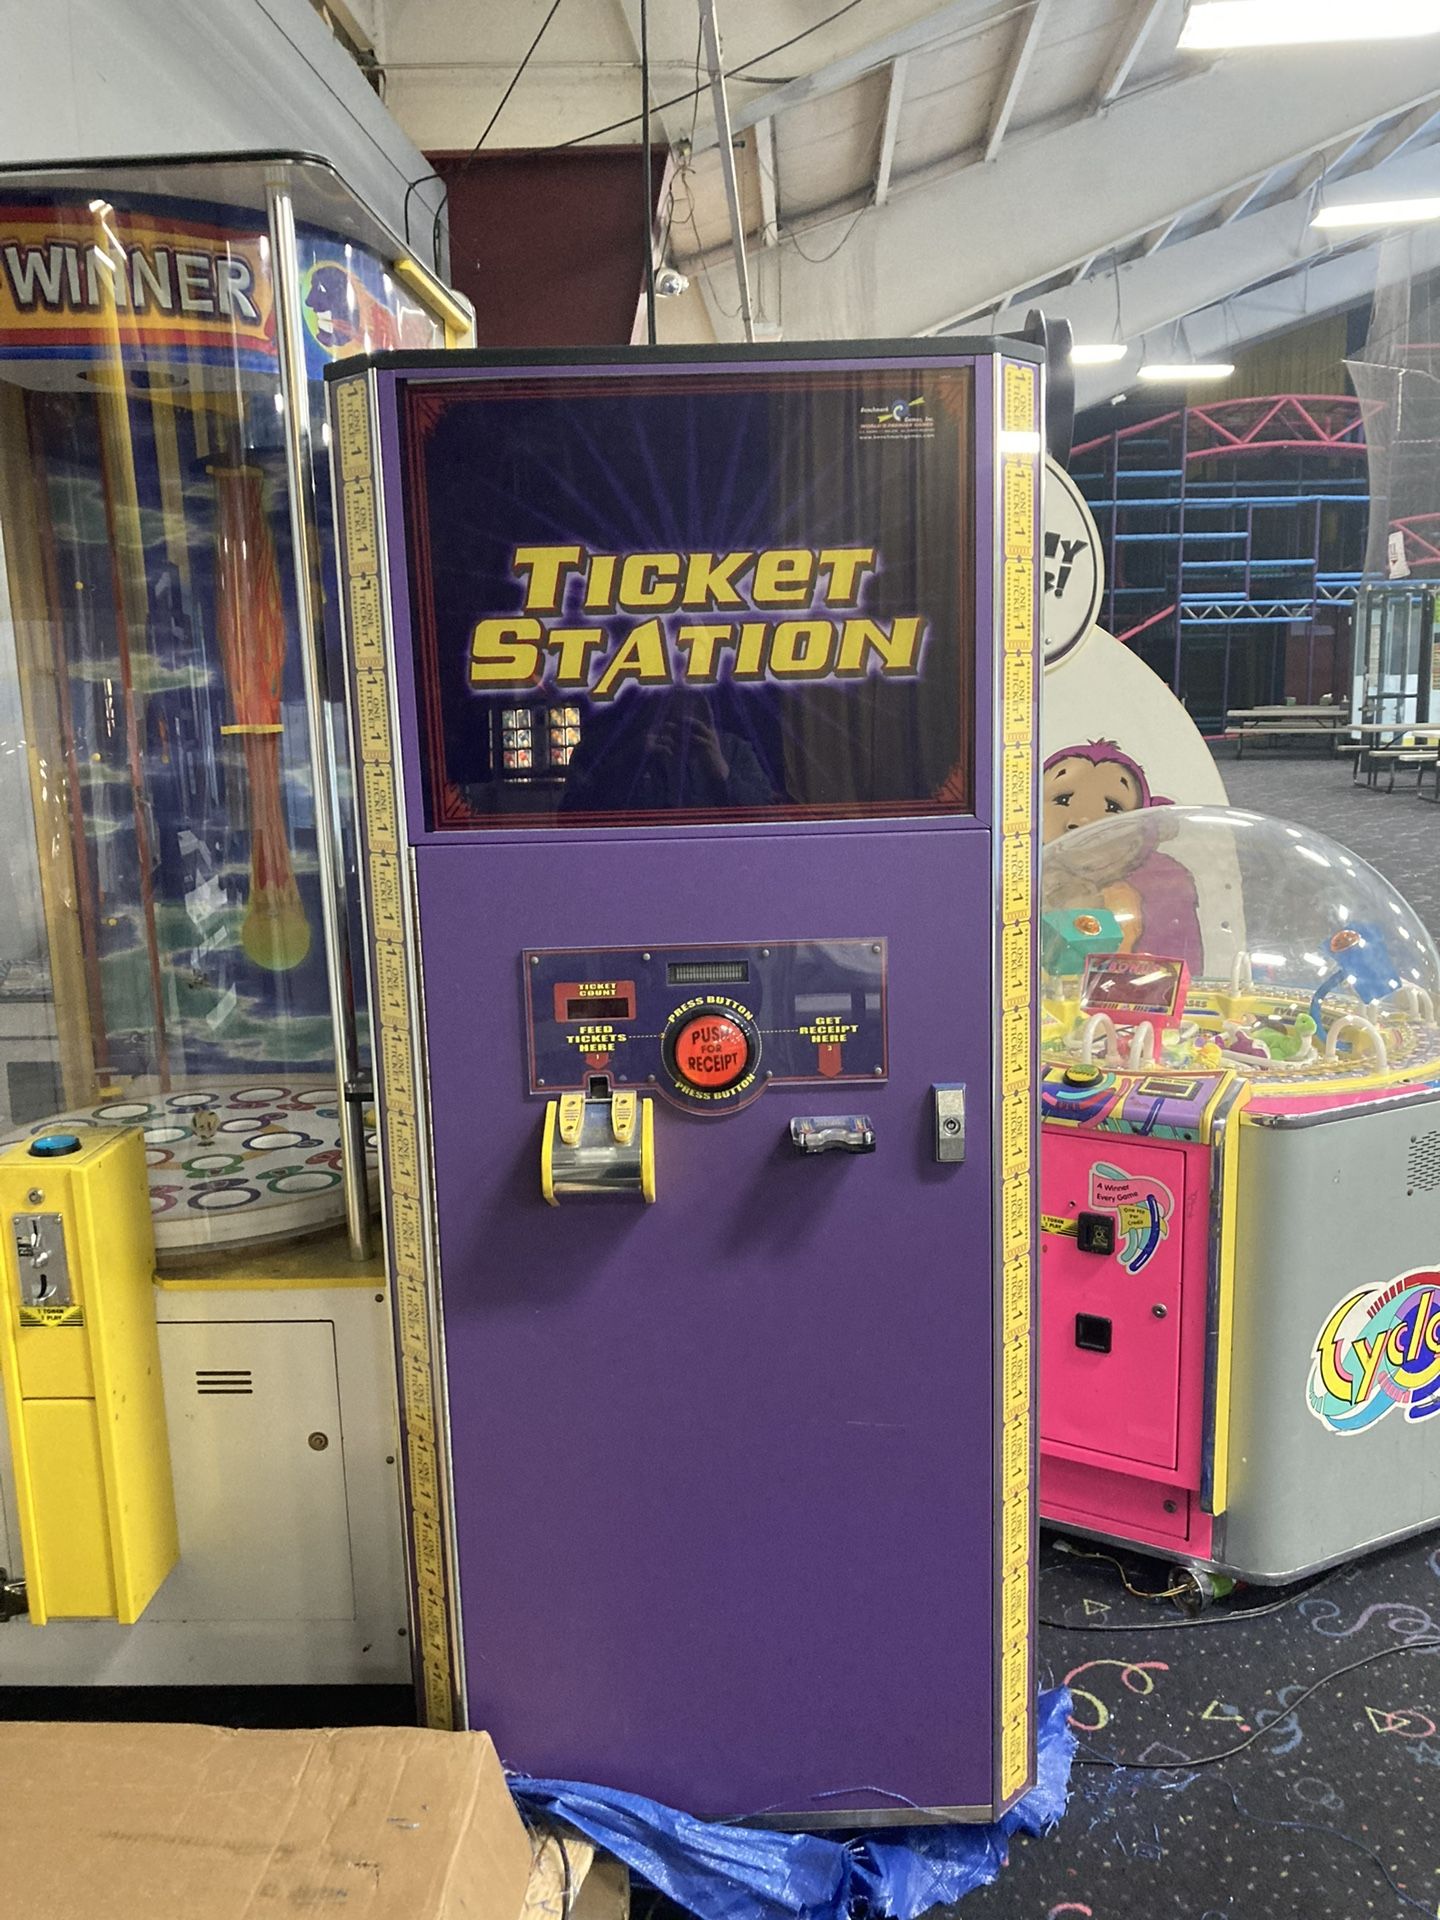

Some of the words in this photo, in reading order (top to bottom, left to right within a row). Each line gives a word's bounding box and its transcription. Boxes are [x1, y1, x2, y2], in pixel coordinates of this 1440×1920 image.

[3, 244, 260, 319] WINNER
[346, 387, 359, 398] 1
[345, 400, 356, 446] TICKET
[352, 409, 361, 436] ONE
[350, 446, 363, 457] 1
[1013, 470, 1026, 479] 1
[353, 485, 365, 495] 1
[1012, 481, 1020, 526] TICKET
[1018, 491, 1026, 517] ONE
[352, 498, 362, 542] TICKET
[359, 506, 367, 533] ONE
[1013, 527, 1026, 536] 1
[356, 543, 369, 553] 1
[1013, 565, 1026, 573] 1
[359, 581, 372, 591] 1
[358, 593, 369, 637] TICKET
[365, 602, 374, 627] ONE
[1013, 621, 1025, 630] 1
[363, 638, 375, 647] 1
[468, 616, 925, 700] STATION
[1013, 658, 1025, 667] 1
[365, 675, 378, 684] 1
[1011, 669, 1019, 712] TICKET
[365, 687, 375, 730] TICKET
[371, 696, 380, 721] ONE
[1013, 713, 1025, 722] 1
[369, 731, 381, 740] 1
[1012, 749, 1025, 759] 1
[372, 768, 384, 776] 1
[1011, 761, 1019, 803] TICKET
[371, 779, 381, 821] TICKET
[377, 788, 386, 812] ONE
[1012, 803, 1025, 813] 1
[375, 822, 387, 830] 1
[1012, 839, 1024, 848] 1
[378, 858, 390, 866] 1
[377, 869, 387, 910] TICKET
[383, 878, 392, 902] ONE
[1012, 892, 1024, 902] 1
[381, 911, 393, 920] 1
[1012, 927, 1024, 937] 1
[384, 947, 396, 955] 1
[1010, 938, 1018, 978] TICKET
[383, 957, 393, 998] TICKET
[389, 966, 398, 990] ONE
[1012, 979, 1024, 989] 1
[579, 989, 617, 997] COUNT
[387, 999, 399, 1007] 1
[667, 997, 704, 1023] PRESS
[706, 995, 754, 1021] BUTTON
[815, 1016, 842, 1025] GET
[1012, 1013, 1024, 1023] 1
[579, 1025, 613, 1034] FEED
[799, 1024, 859, 1034] RECEIPT
[389, 1033, 401, 1042] 1
[566, 1033, 627, 1044] TICKETS
[811, 1034, 847, 1043] HERE
[579, 1043, 615, 1052] HERE
[701, 1044, 722, 1054] FOR
[1010, 1024, 1018, 1064] TICKET
[389, 1044, 398, 1083] TICKET
[395, 1052, 403, 1076] ONE
[688, 1052, 738, 1073] RECEIPT
[1011, 1064, 1023, 1074] 1
[393, 1084, 405, 1093] 1
[675, 1081, 711, 1100] PRESS
[713, 1073, 755, 1100] BUTTON
[1104, 1183, 1130, 1192] Winner
[1096, 1192, 1116, 1203] Every
[1117, 1191, 1138, 1201] Game
